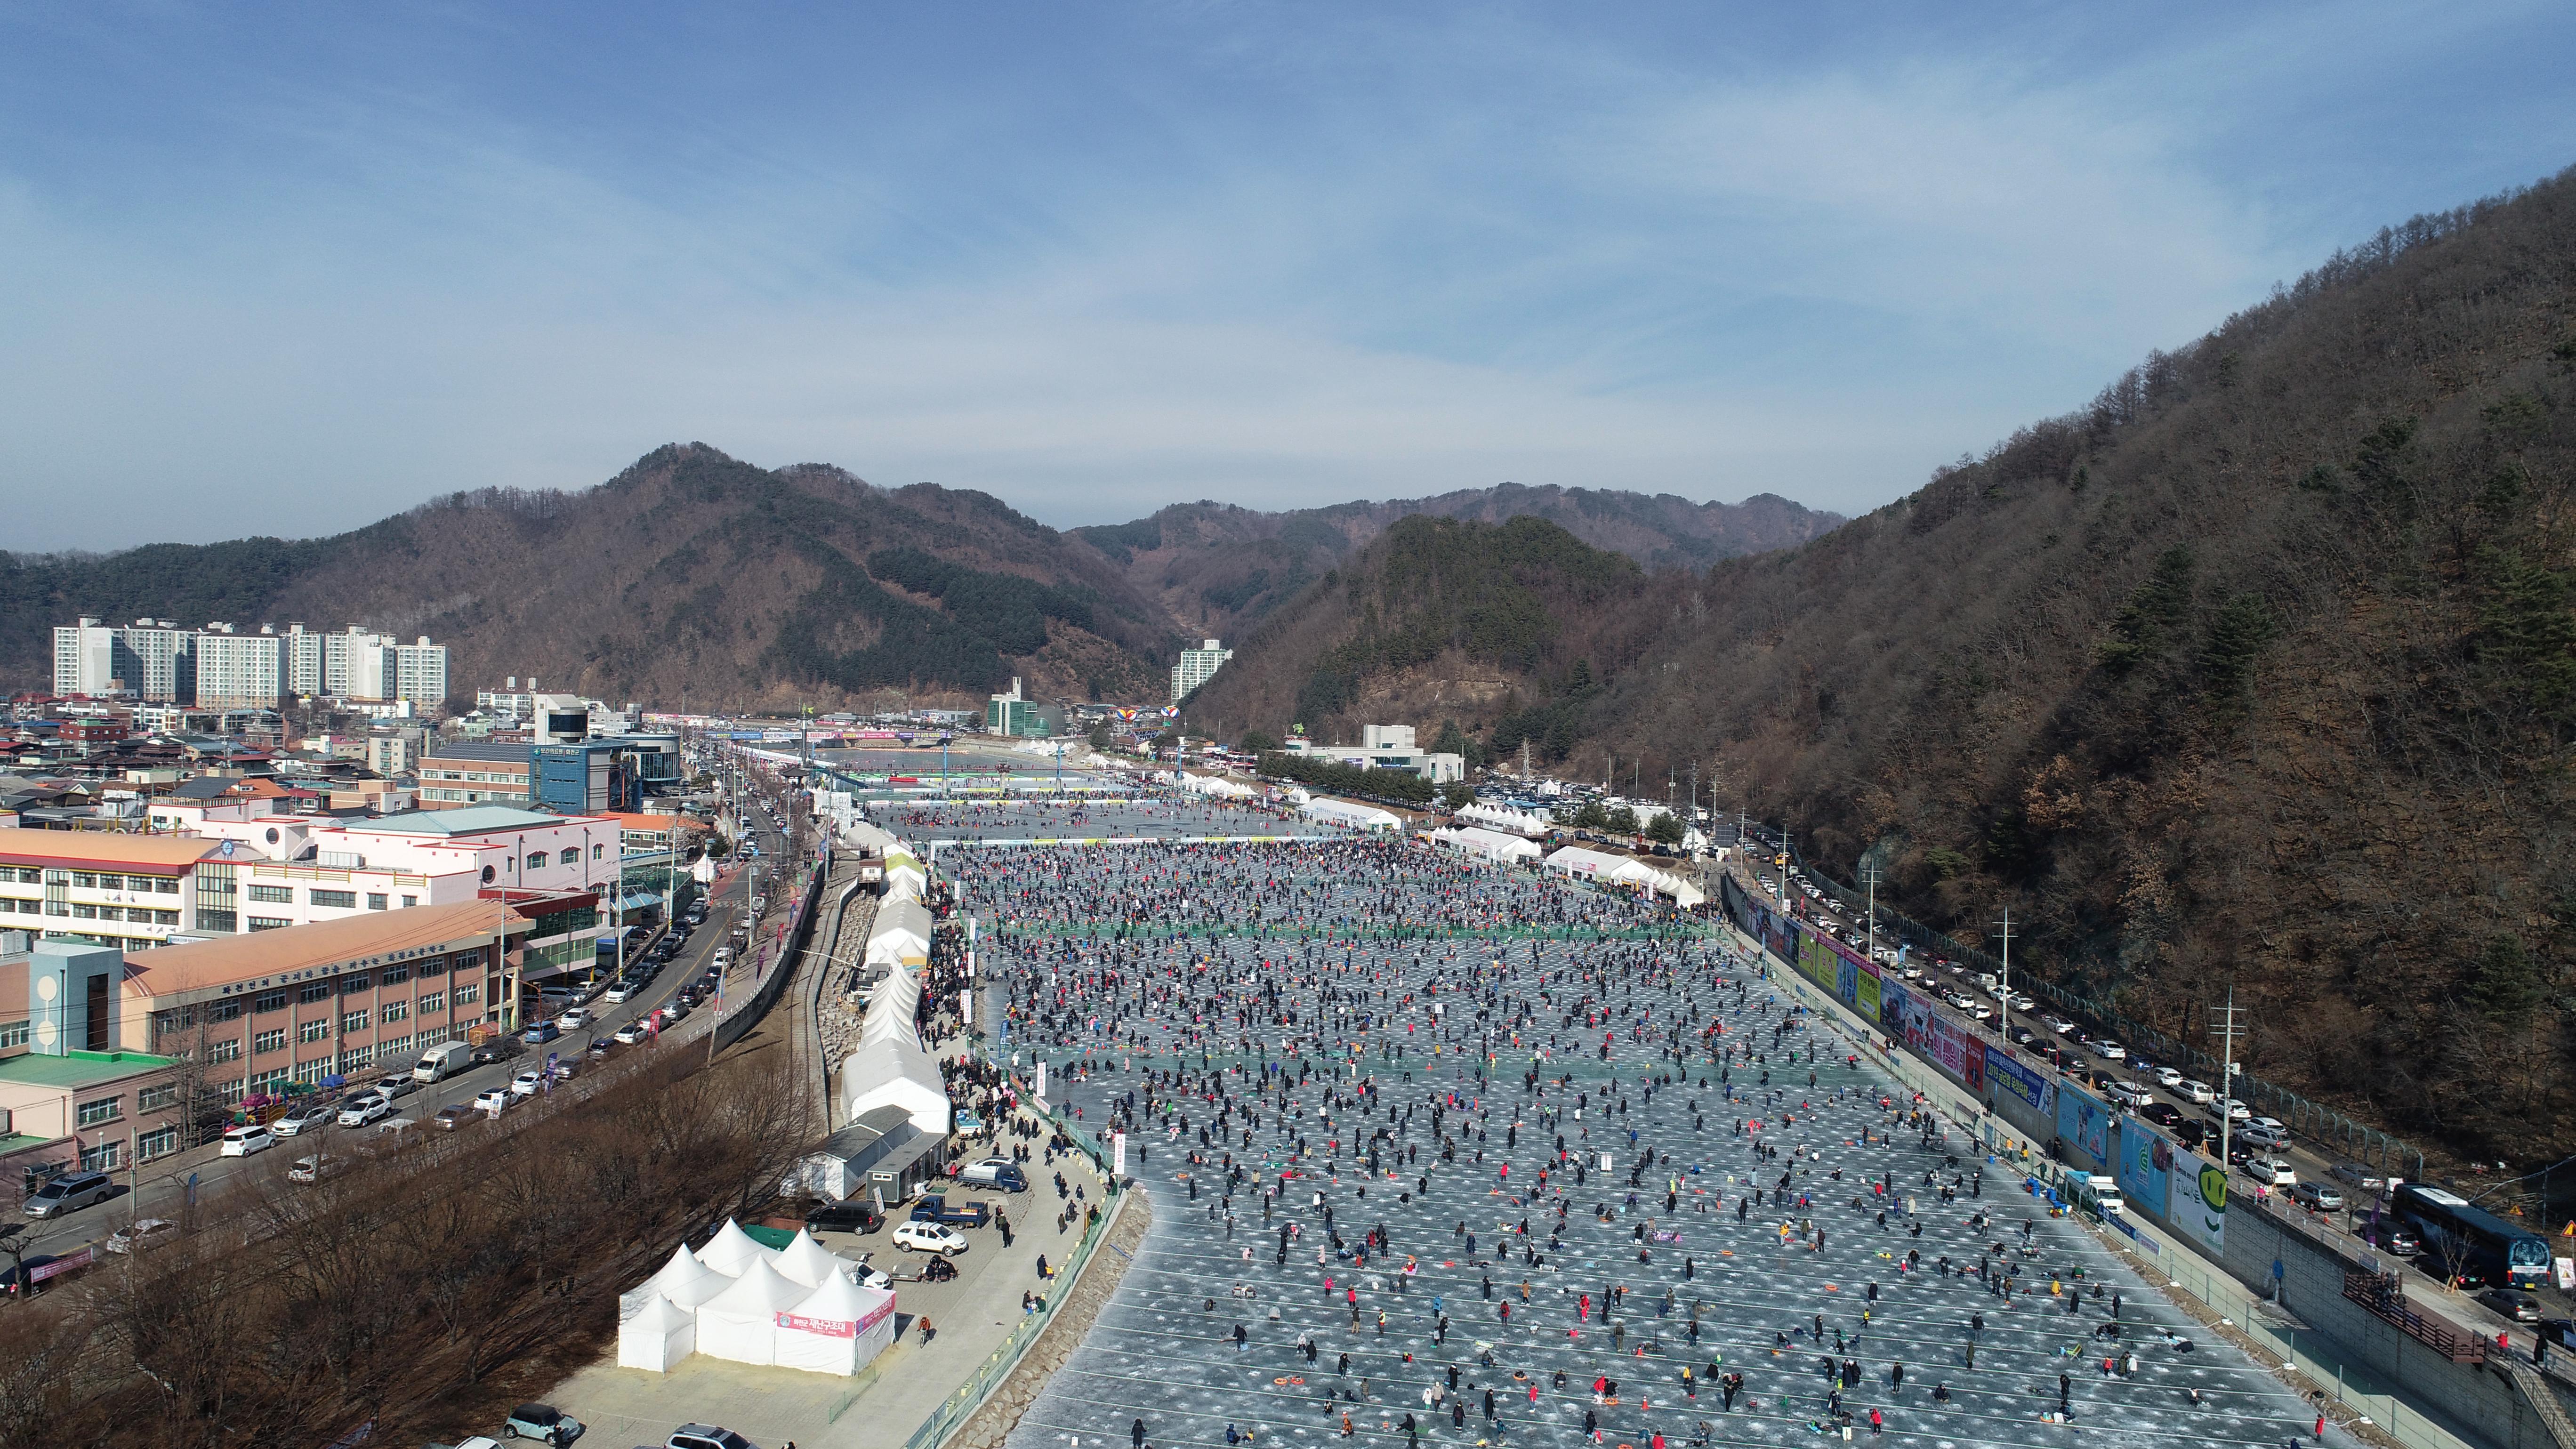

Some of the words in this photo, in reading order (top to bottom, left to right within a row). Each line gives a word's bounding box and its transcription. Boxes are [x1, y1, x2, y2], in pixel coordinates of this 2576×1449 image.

[222, 978, 269, 995] 화천인의
[280, 969, 314, 983] 긍지와
[321, 965, 340, 975] 꿈을
[349, 957, 380, 969] 키우는
[388, 944, 446, 961] 화천초등학교
[1866, 962, 1877, 977] Fishing
[1987, 1062, 1999, 1079] 2019
[1998, 1069, 2011, 1088] 글로벌
[2028, 1090, 2037, 1105] 선정
[793, 1318, 808, 1328] 화천군
[809, 1318, 846, 1333] 재난구조대
